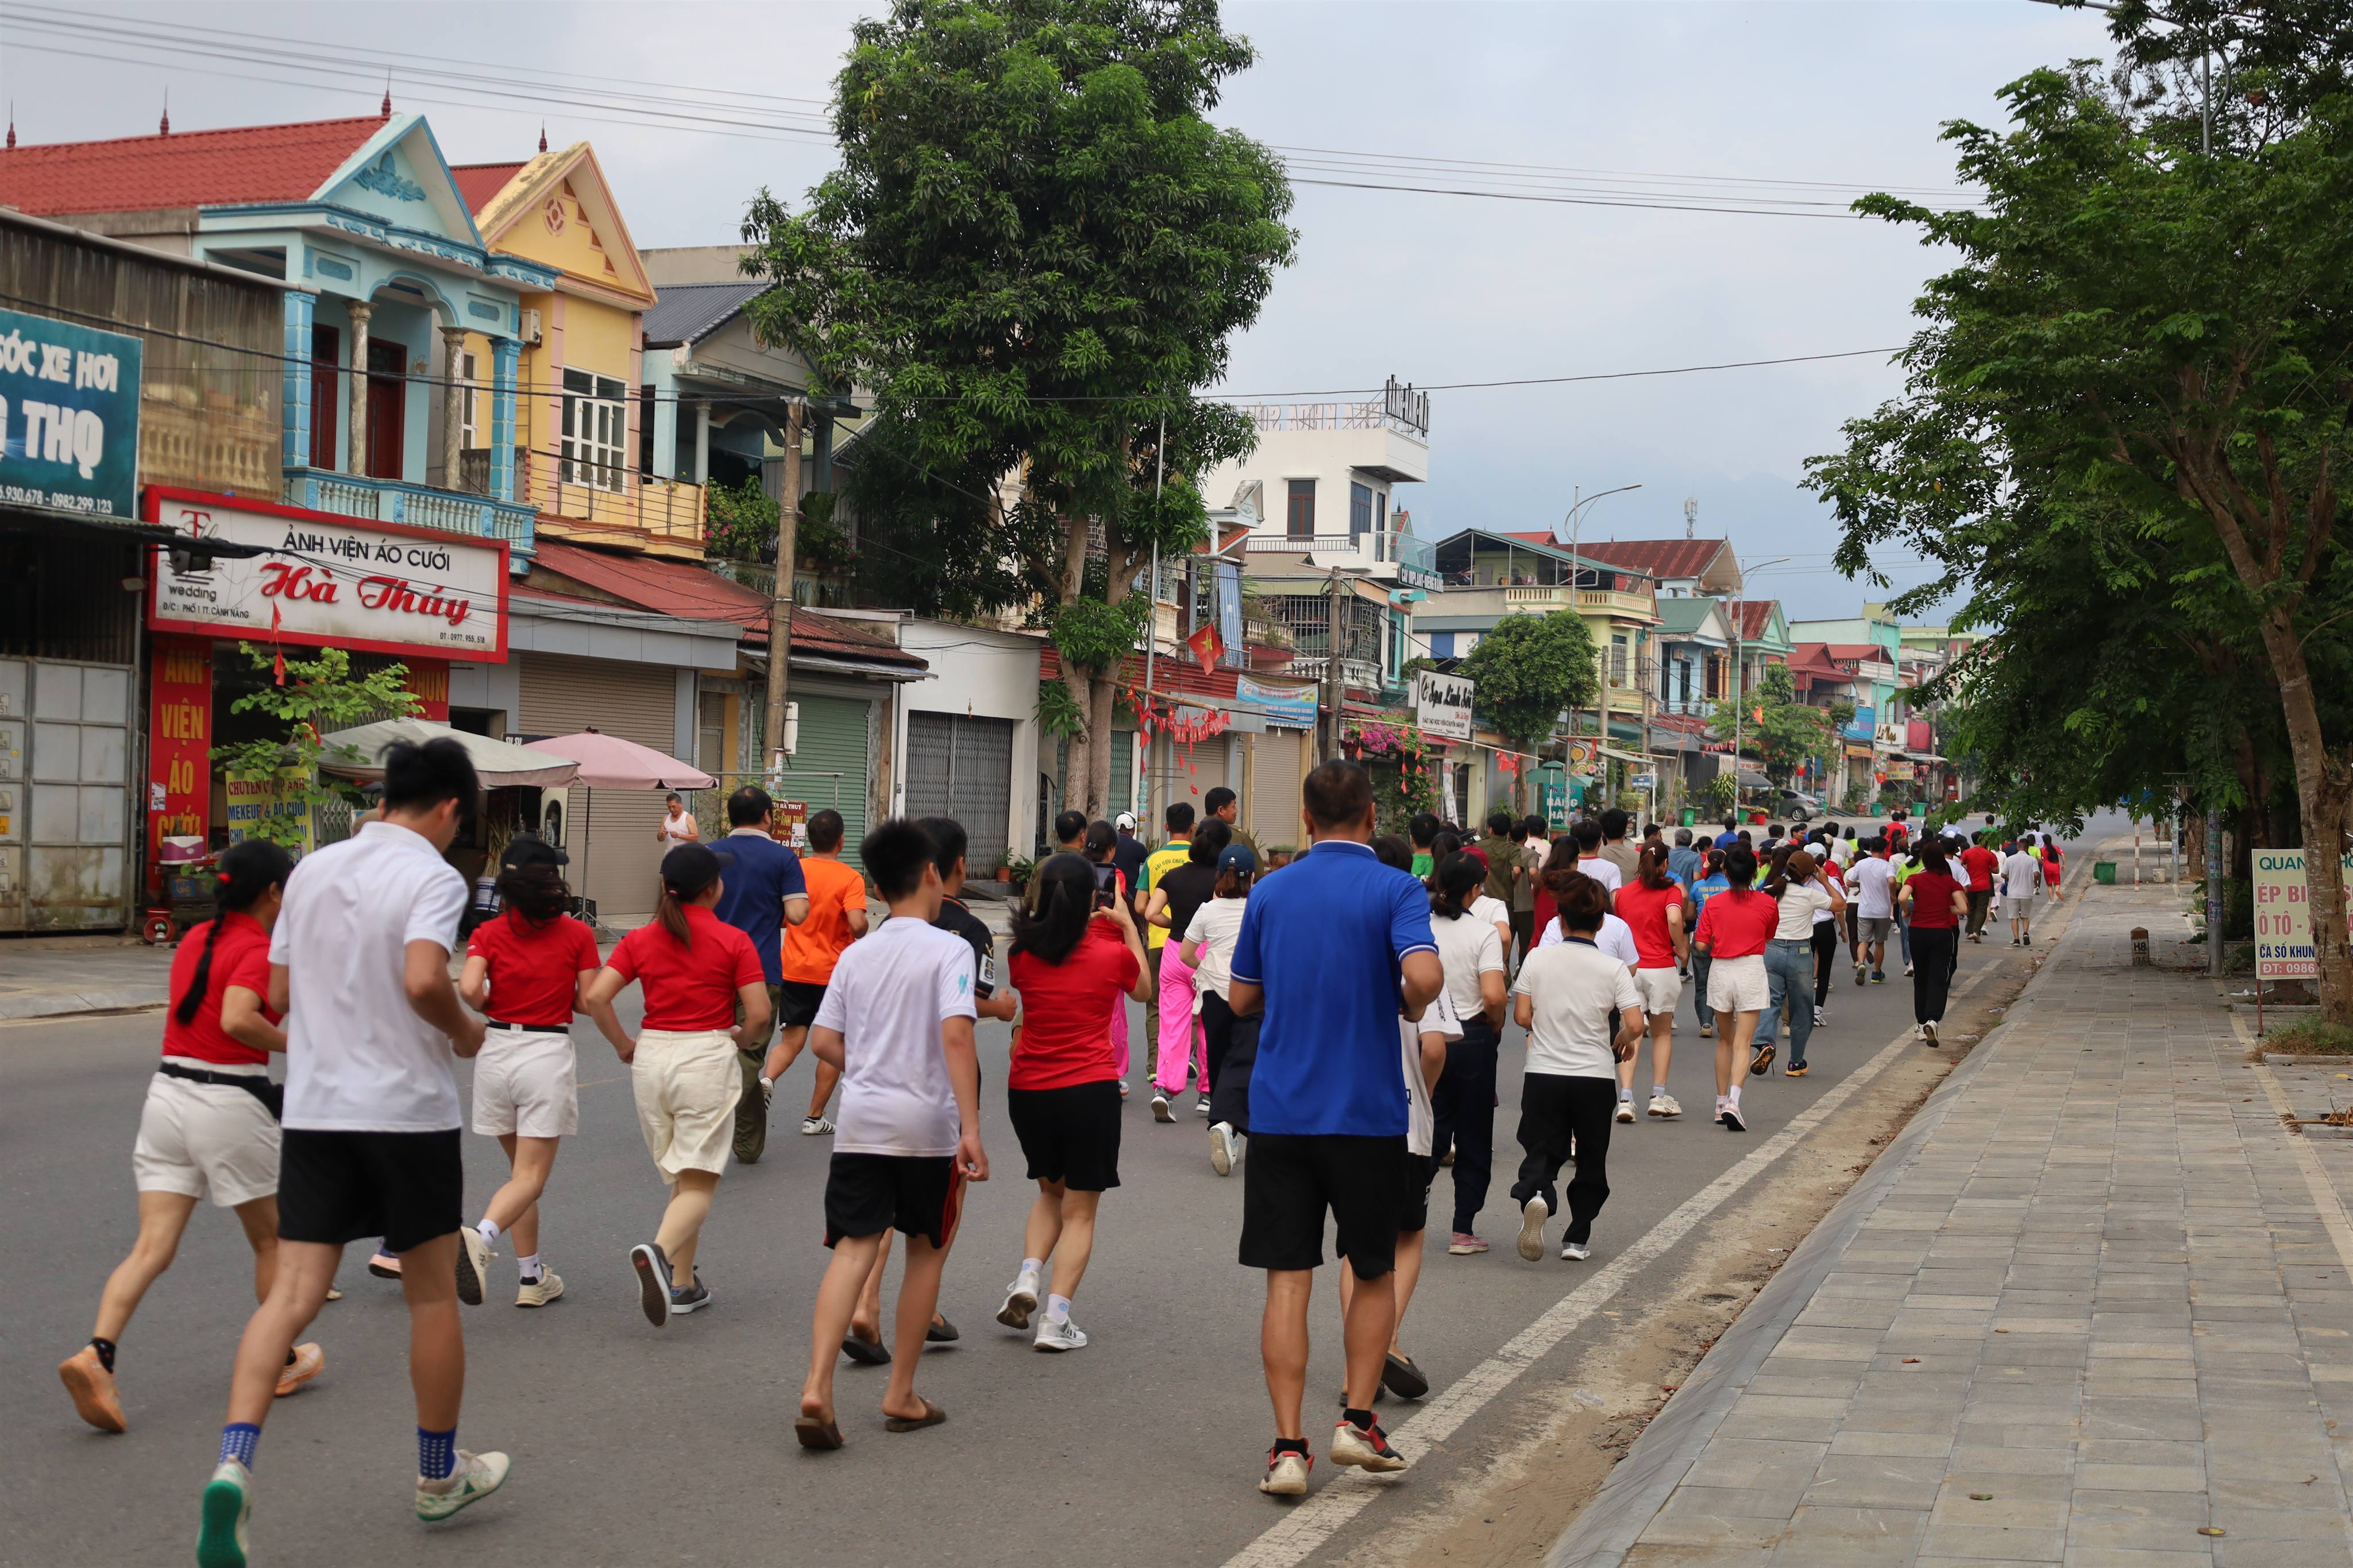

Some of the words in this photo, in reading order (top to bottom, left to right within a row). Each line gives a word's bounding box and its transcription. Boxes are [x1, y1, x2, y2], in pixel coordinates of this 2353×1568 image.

[38, 343, 71, 384] XE
[76, 350, 118, 393] HƠI
[51, 492, 113, 514] 0982.299.123
[283, 524, 324, 553] ẢNH
[329, 535, 369, 562] VIỆN
[375, 538, 402, 563] ÁO
[407, 546, 450, 571] CƯỚI
[169, 585, 217, 602] wedding
[259, 562, 340, 604] Hà
[357, 576, 472, 626] Thúy
[183, 602, 196, 613] PHỐ
[161, 697, 203, 746] VIỆN
[168, 752, 194, 794] ÁO
[1546, 797, 1578, 808] RĂG
[2258, 882, 2281, 903] ÉP
[2259, 910, 2268, 936] Ô
[2273, 910, 2292, 936] TÔ
[2134, 942, 2146, 951] H8
[2259, 943, 2271, 959] CÀ
[2275, 941, 2287, 959] SỐ
[2262, 963, 2282, 974] ĐT:
